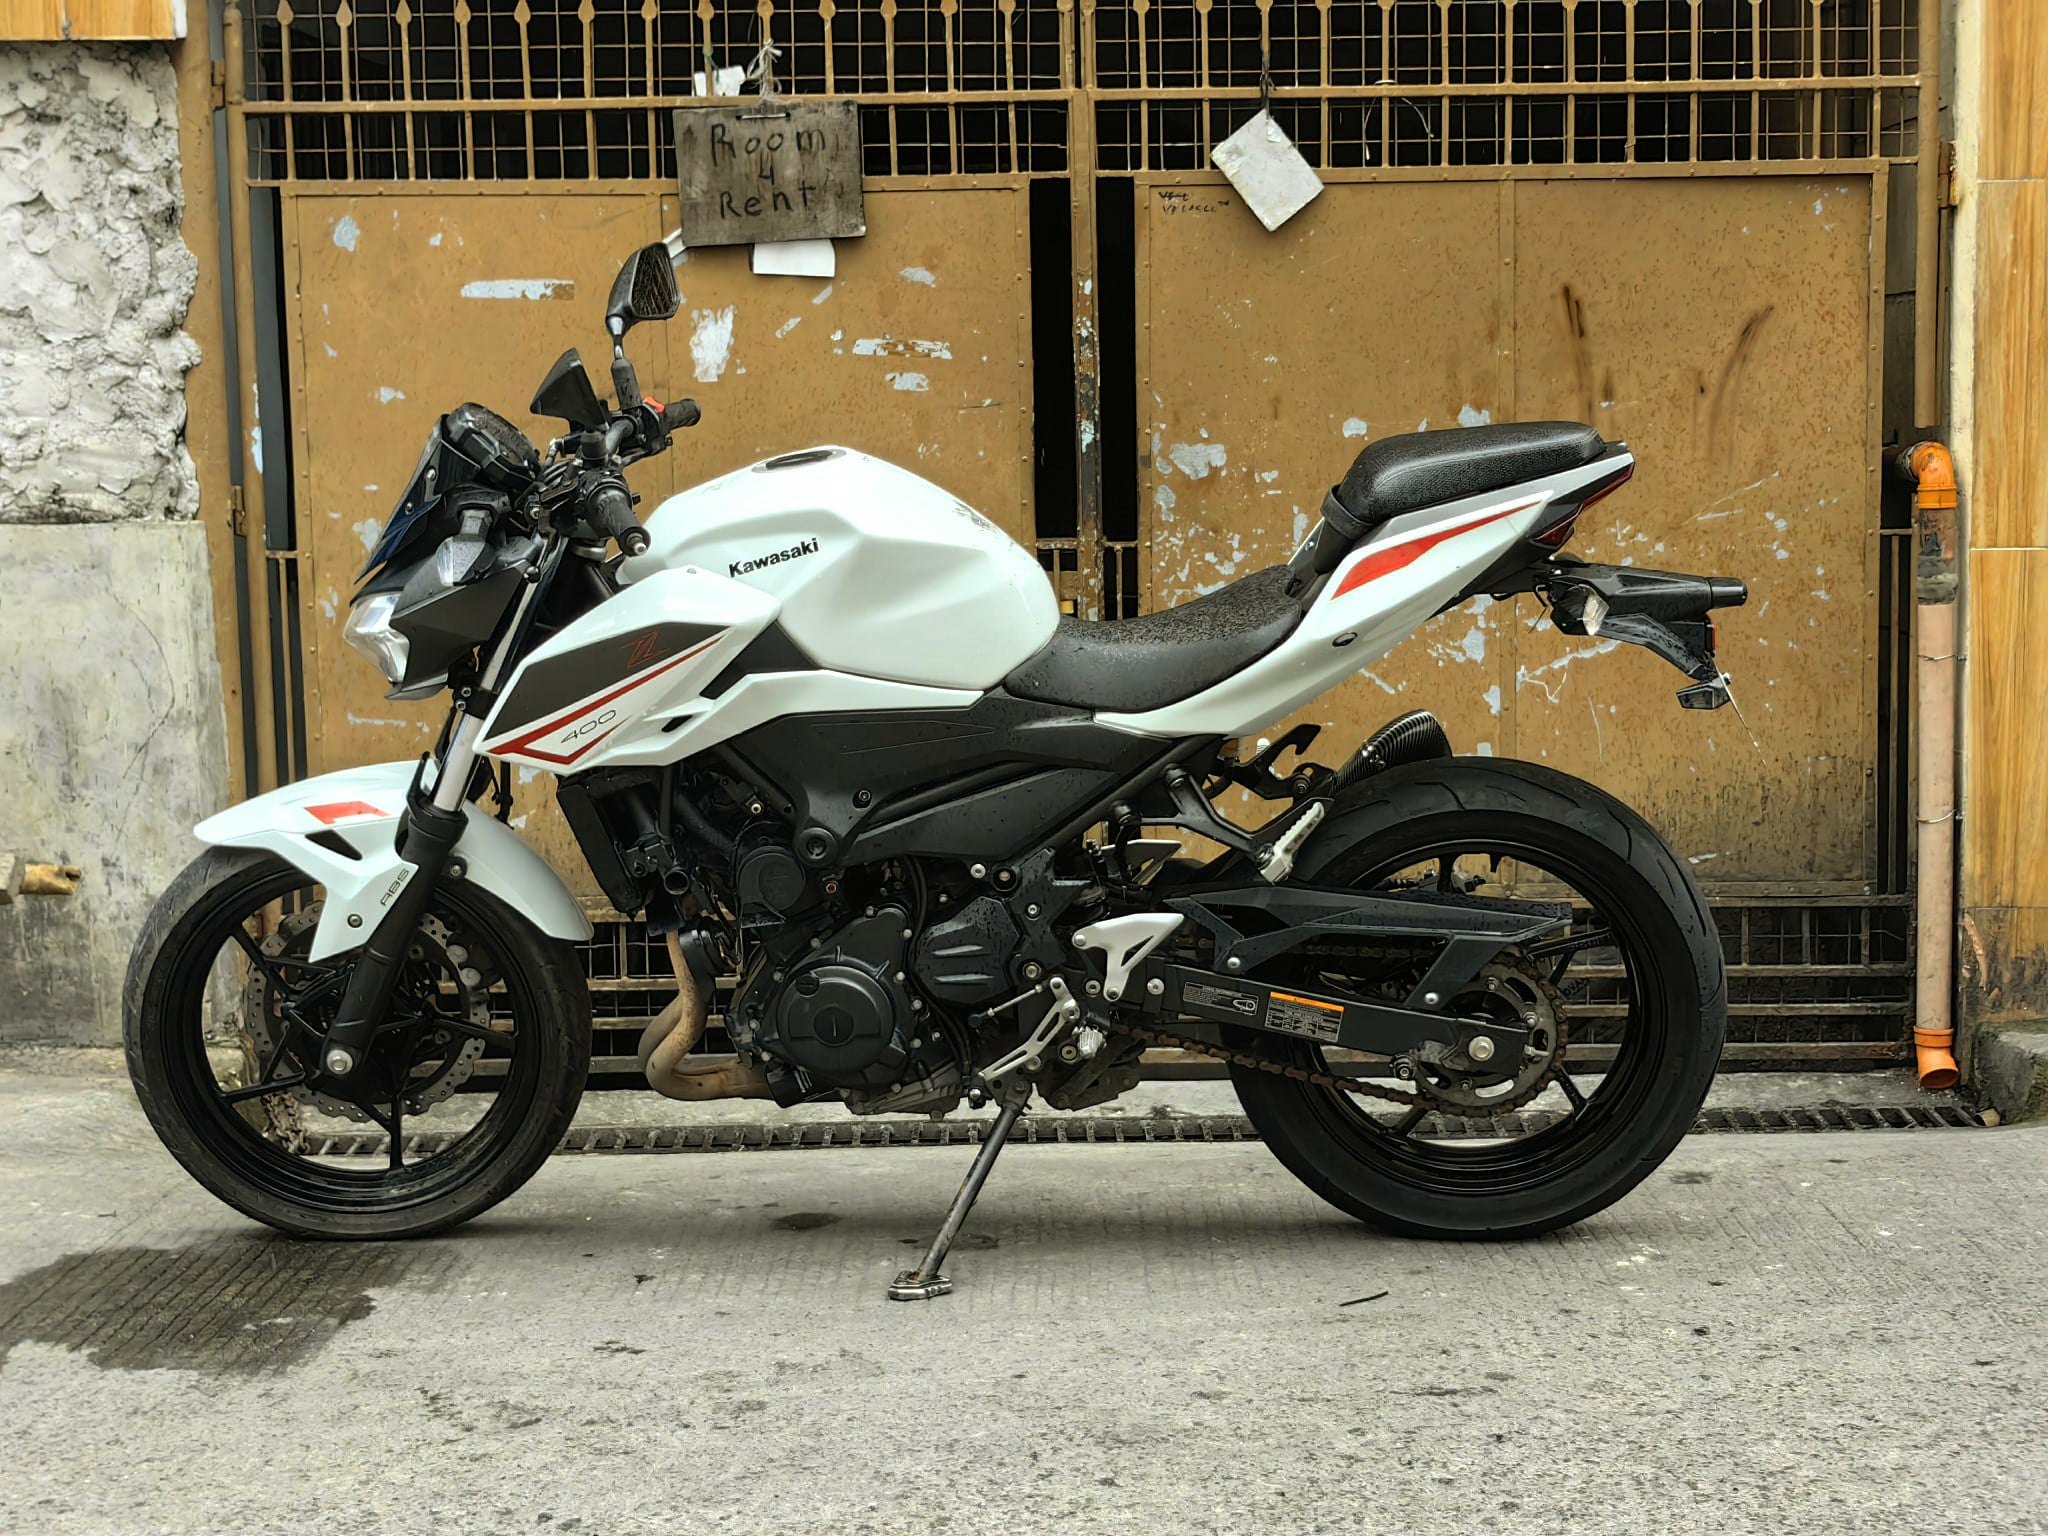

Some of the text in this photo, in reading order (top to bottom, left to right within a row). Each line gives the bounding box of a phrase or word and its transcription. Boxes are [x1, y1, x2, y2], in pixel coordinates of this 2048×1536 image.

[711, 123, 826, 166] Room
[758, 150, 775, 185] 4
[719, 180, 816, 219] Rent
[728, 537, 819, 578] Kawasaki
[560, 709, 617, 744] 400
[380, 868, 410, 907] ABS
